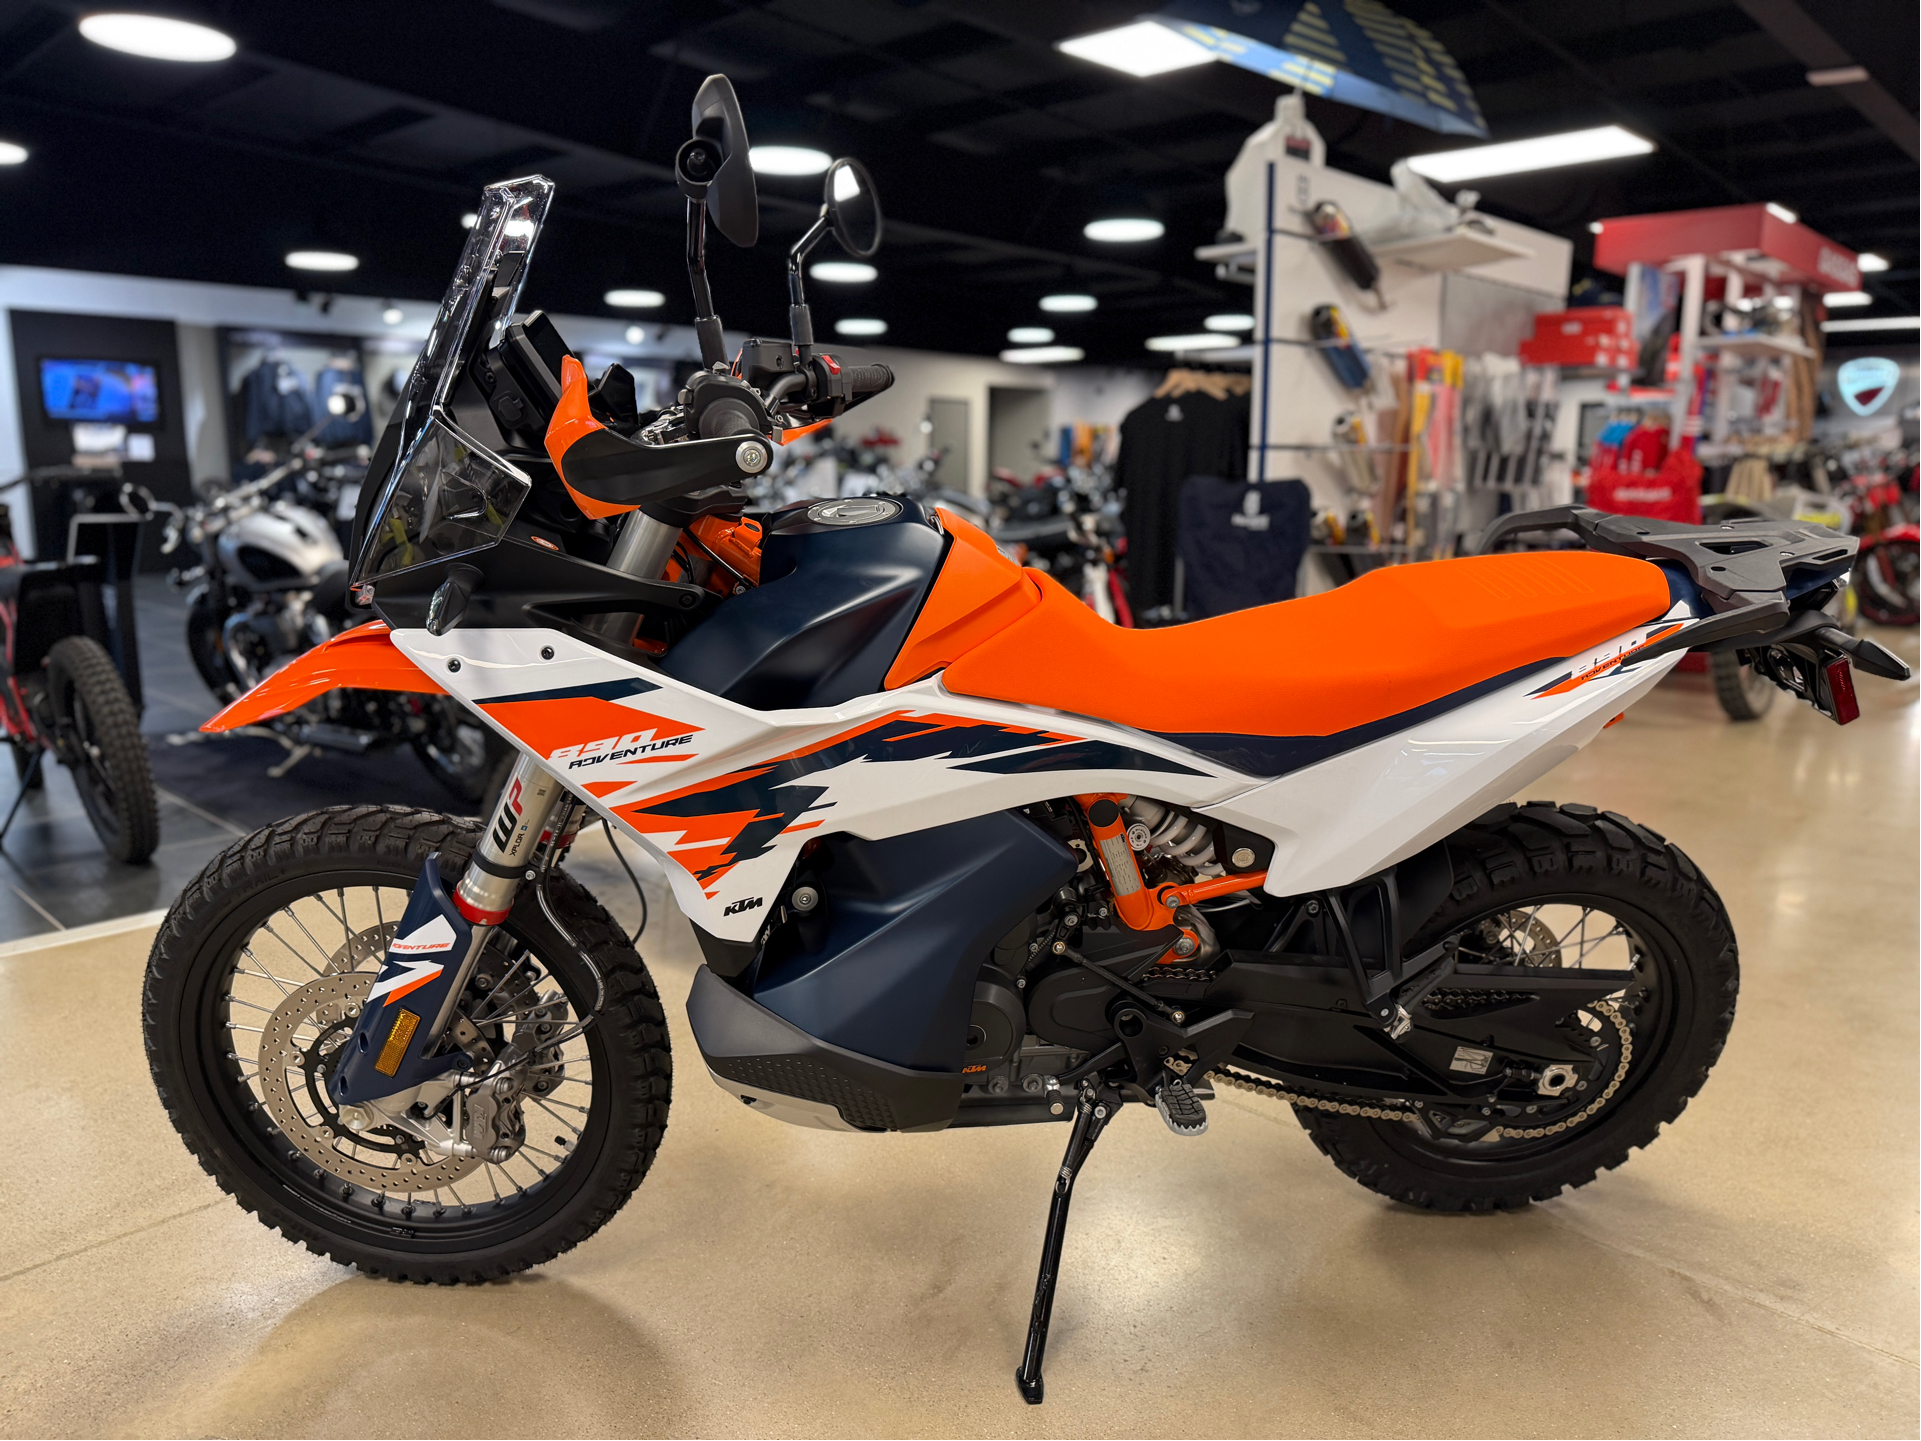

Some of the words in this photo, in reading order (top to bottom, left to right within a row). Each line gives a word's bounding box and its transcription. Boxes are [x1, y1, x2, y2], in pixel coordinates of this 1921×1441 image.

[549, 728, 658, 761] 890
[568, 734, 694, 770] ADVENTURE
[493, 777, 523, 854] WP
[509, 832, 525, 857] XPLOR
[723, 896, 763, 917] KTM
[962, 1064, 987, 1074] KTM
